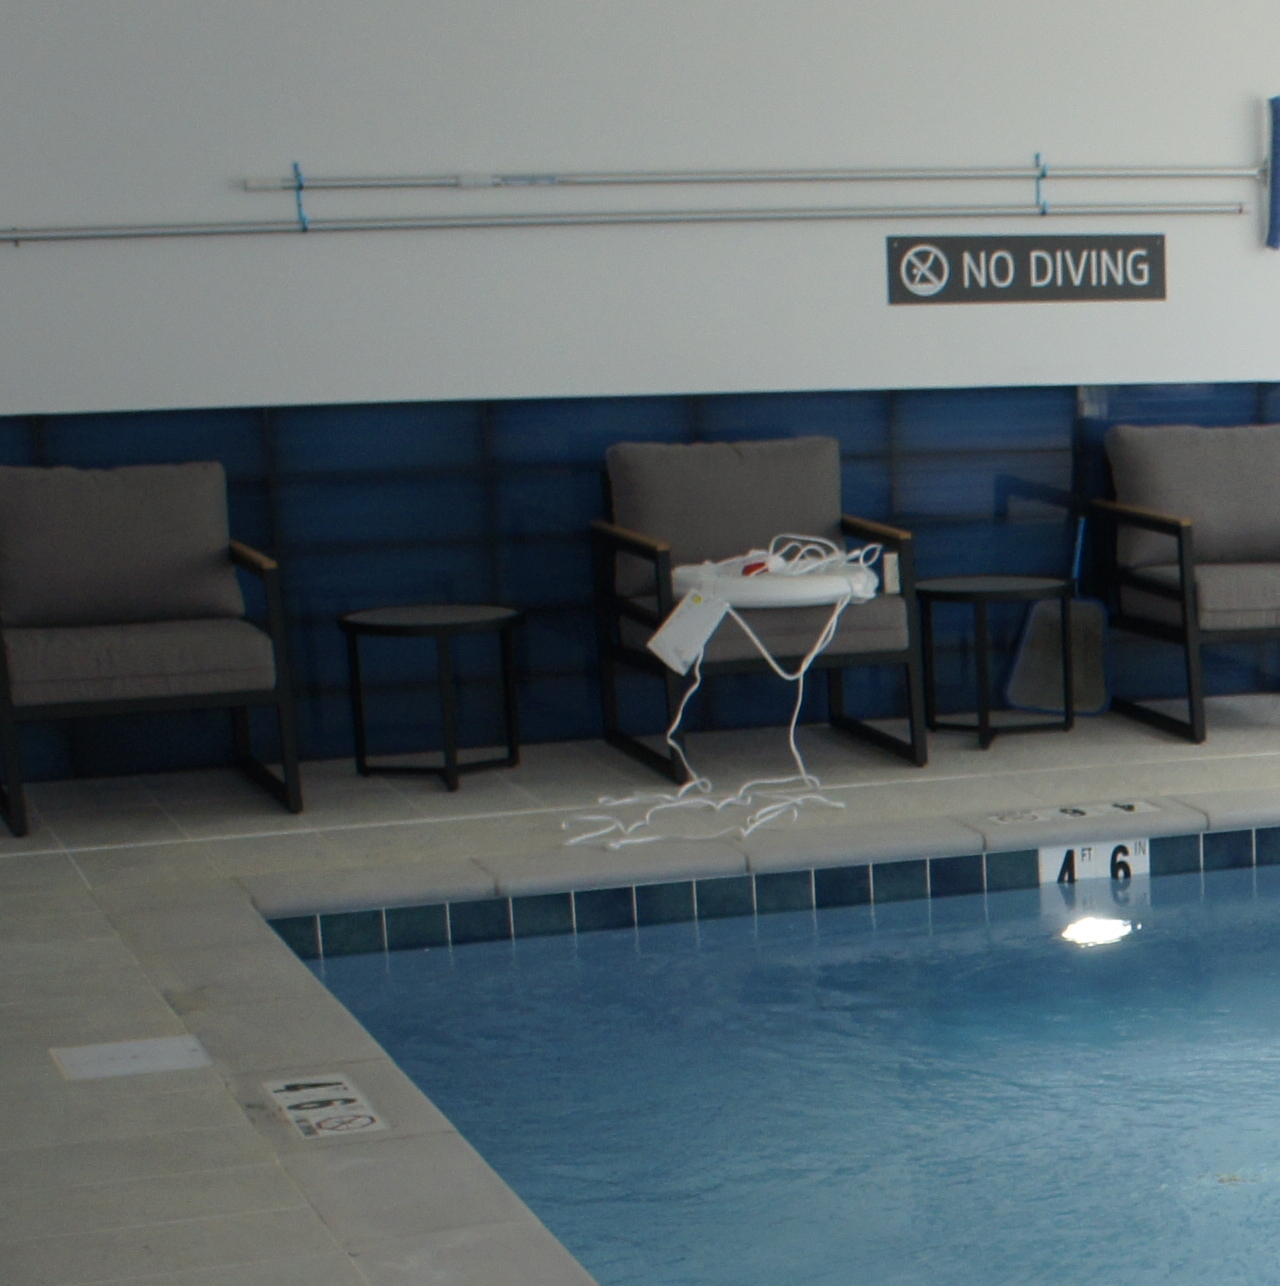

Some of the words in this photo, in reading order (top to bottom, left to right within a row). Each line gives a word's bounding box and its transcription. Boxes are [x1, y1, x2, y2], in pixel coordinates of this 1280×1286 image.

[962, 249, 1015, 289] NO
[1029, 248, 1150, 288] DIVING
[1057, 849, 1076, 884] 4
[1081, 847, 1093, 863] FT
[1110, 844, 1131, 880] 6
